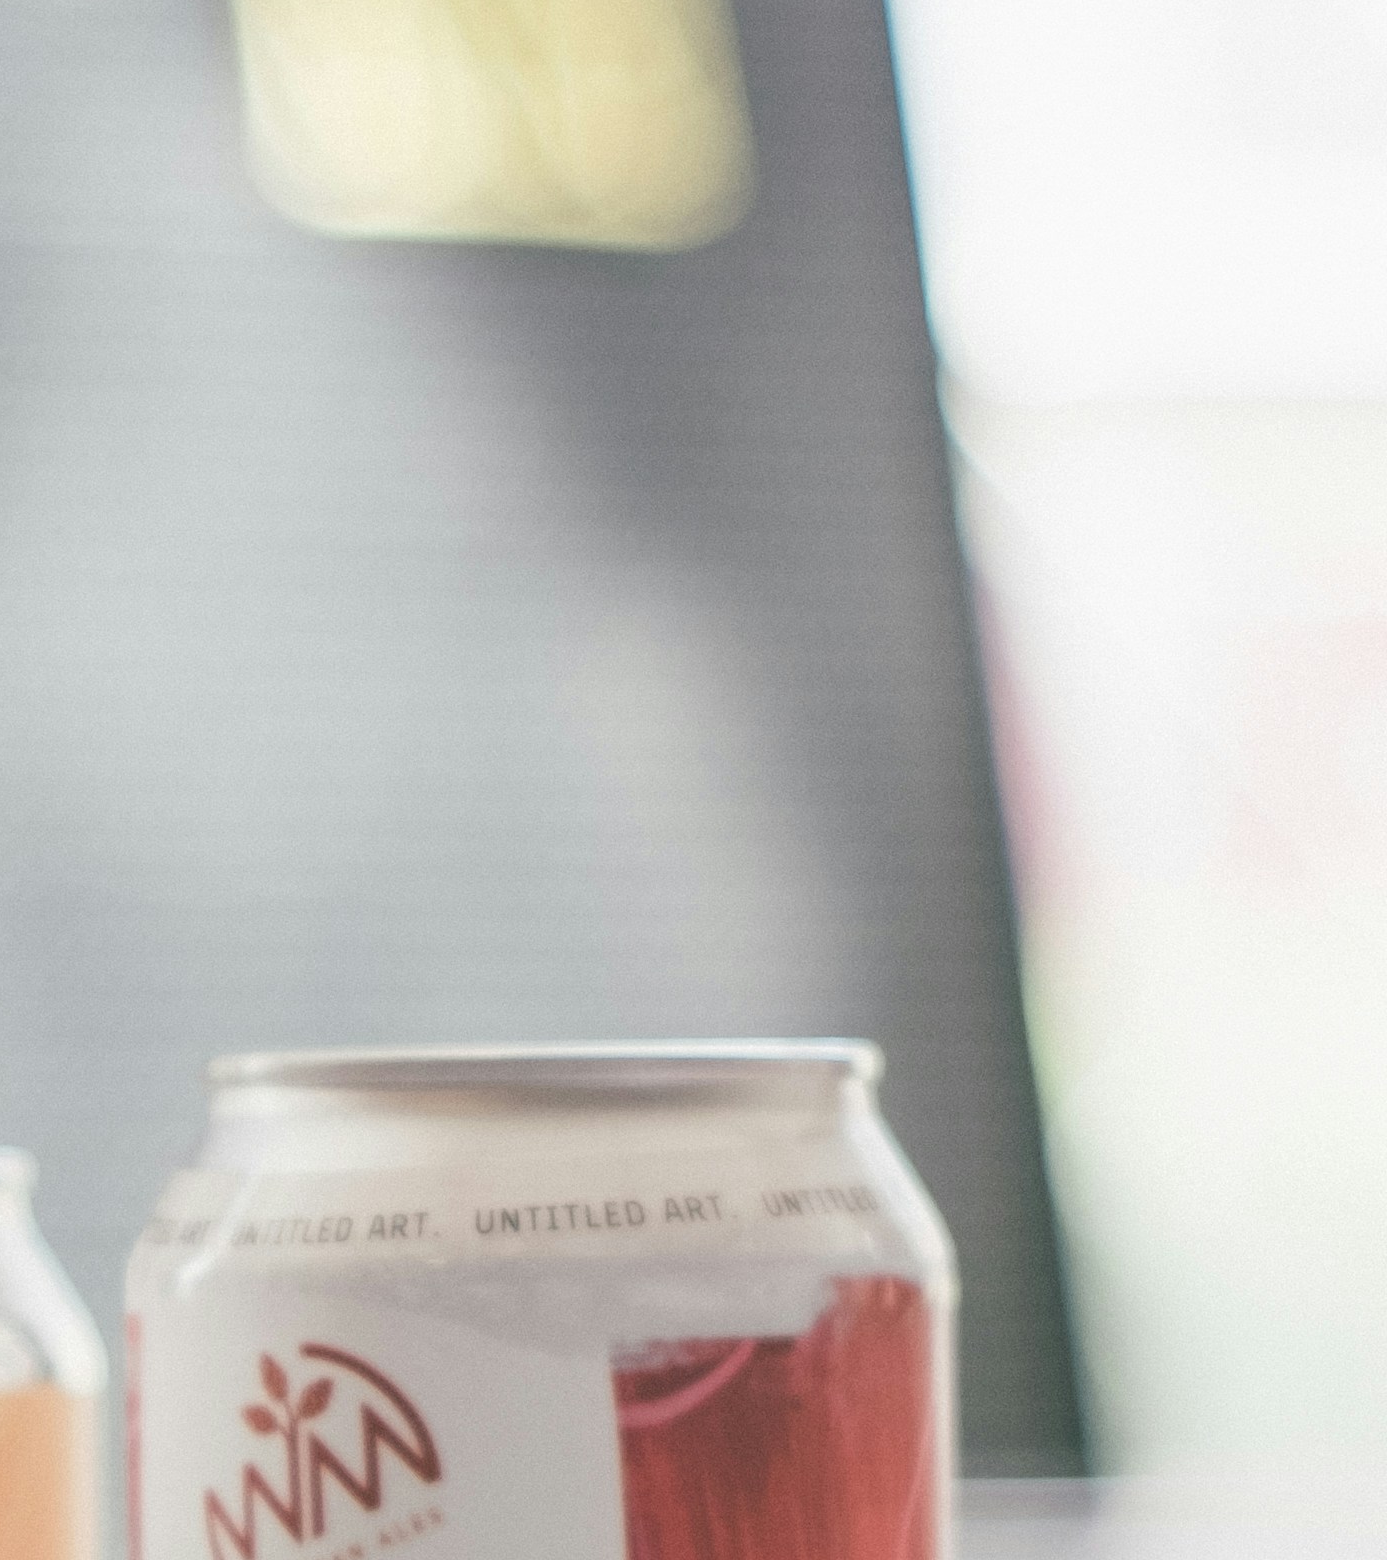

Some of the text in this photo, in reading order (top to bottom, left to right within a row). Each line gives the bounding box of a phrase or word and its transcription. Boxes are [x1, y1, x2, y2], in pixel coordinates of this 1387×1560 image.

[367, 1211, 440, 1241] ART.
[474, 1199, 646, 1235] UNTITLED
[663, 1193, 738, 1224] ART.
